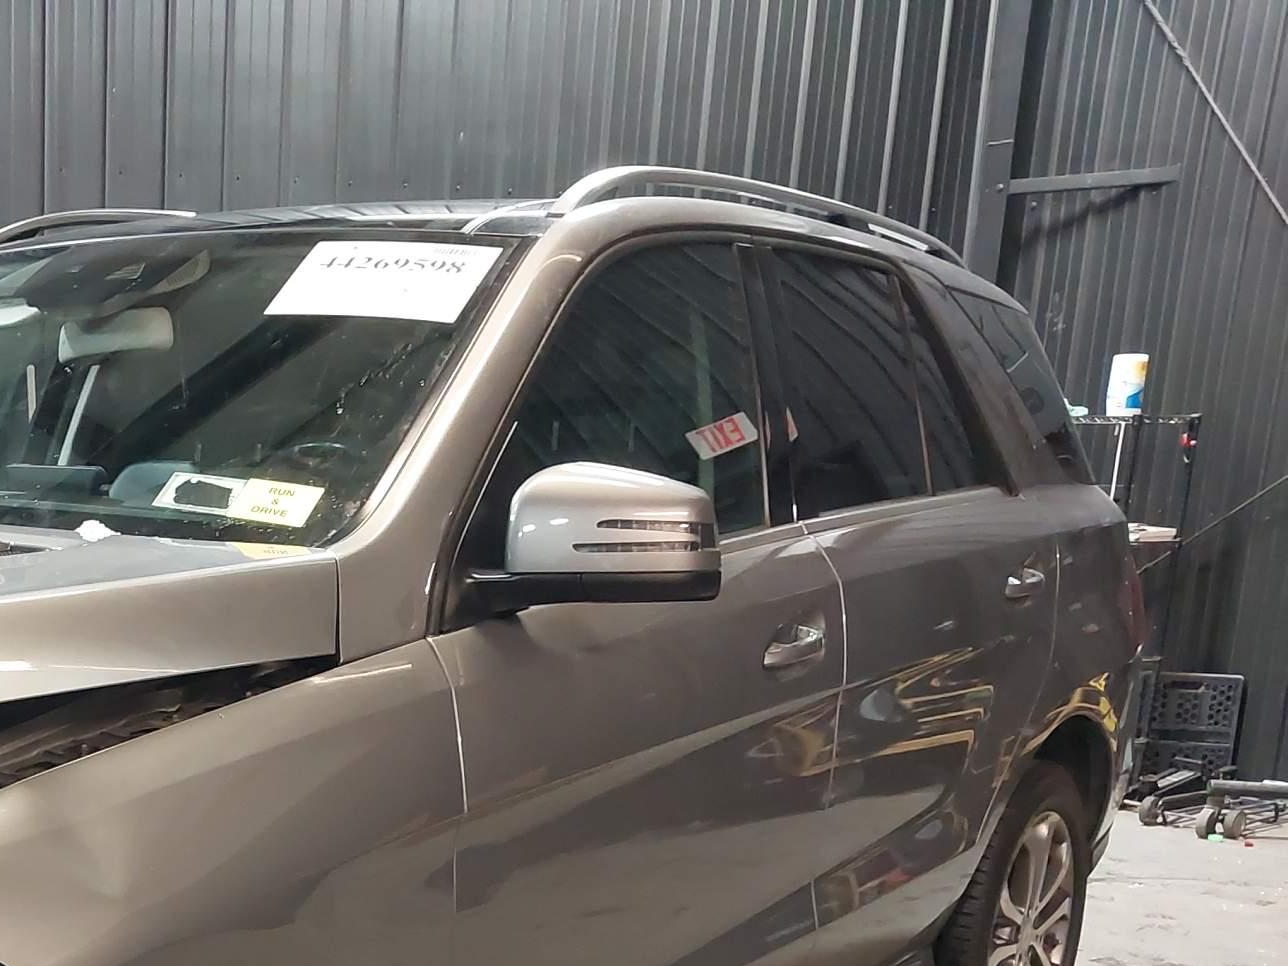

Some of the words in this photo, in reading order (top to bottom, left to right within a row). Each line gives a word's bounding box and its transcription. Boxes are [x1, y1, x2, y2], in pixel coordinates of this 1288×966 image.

[319, 256, 468, 274] 44269598
[268, 488, 295, 496] RUN
[251, 506, 288, 517] DRIVE
